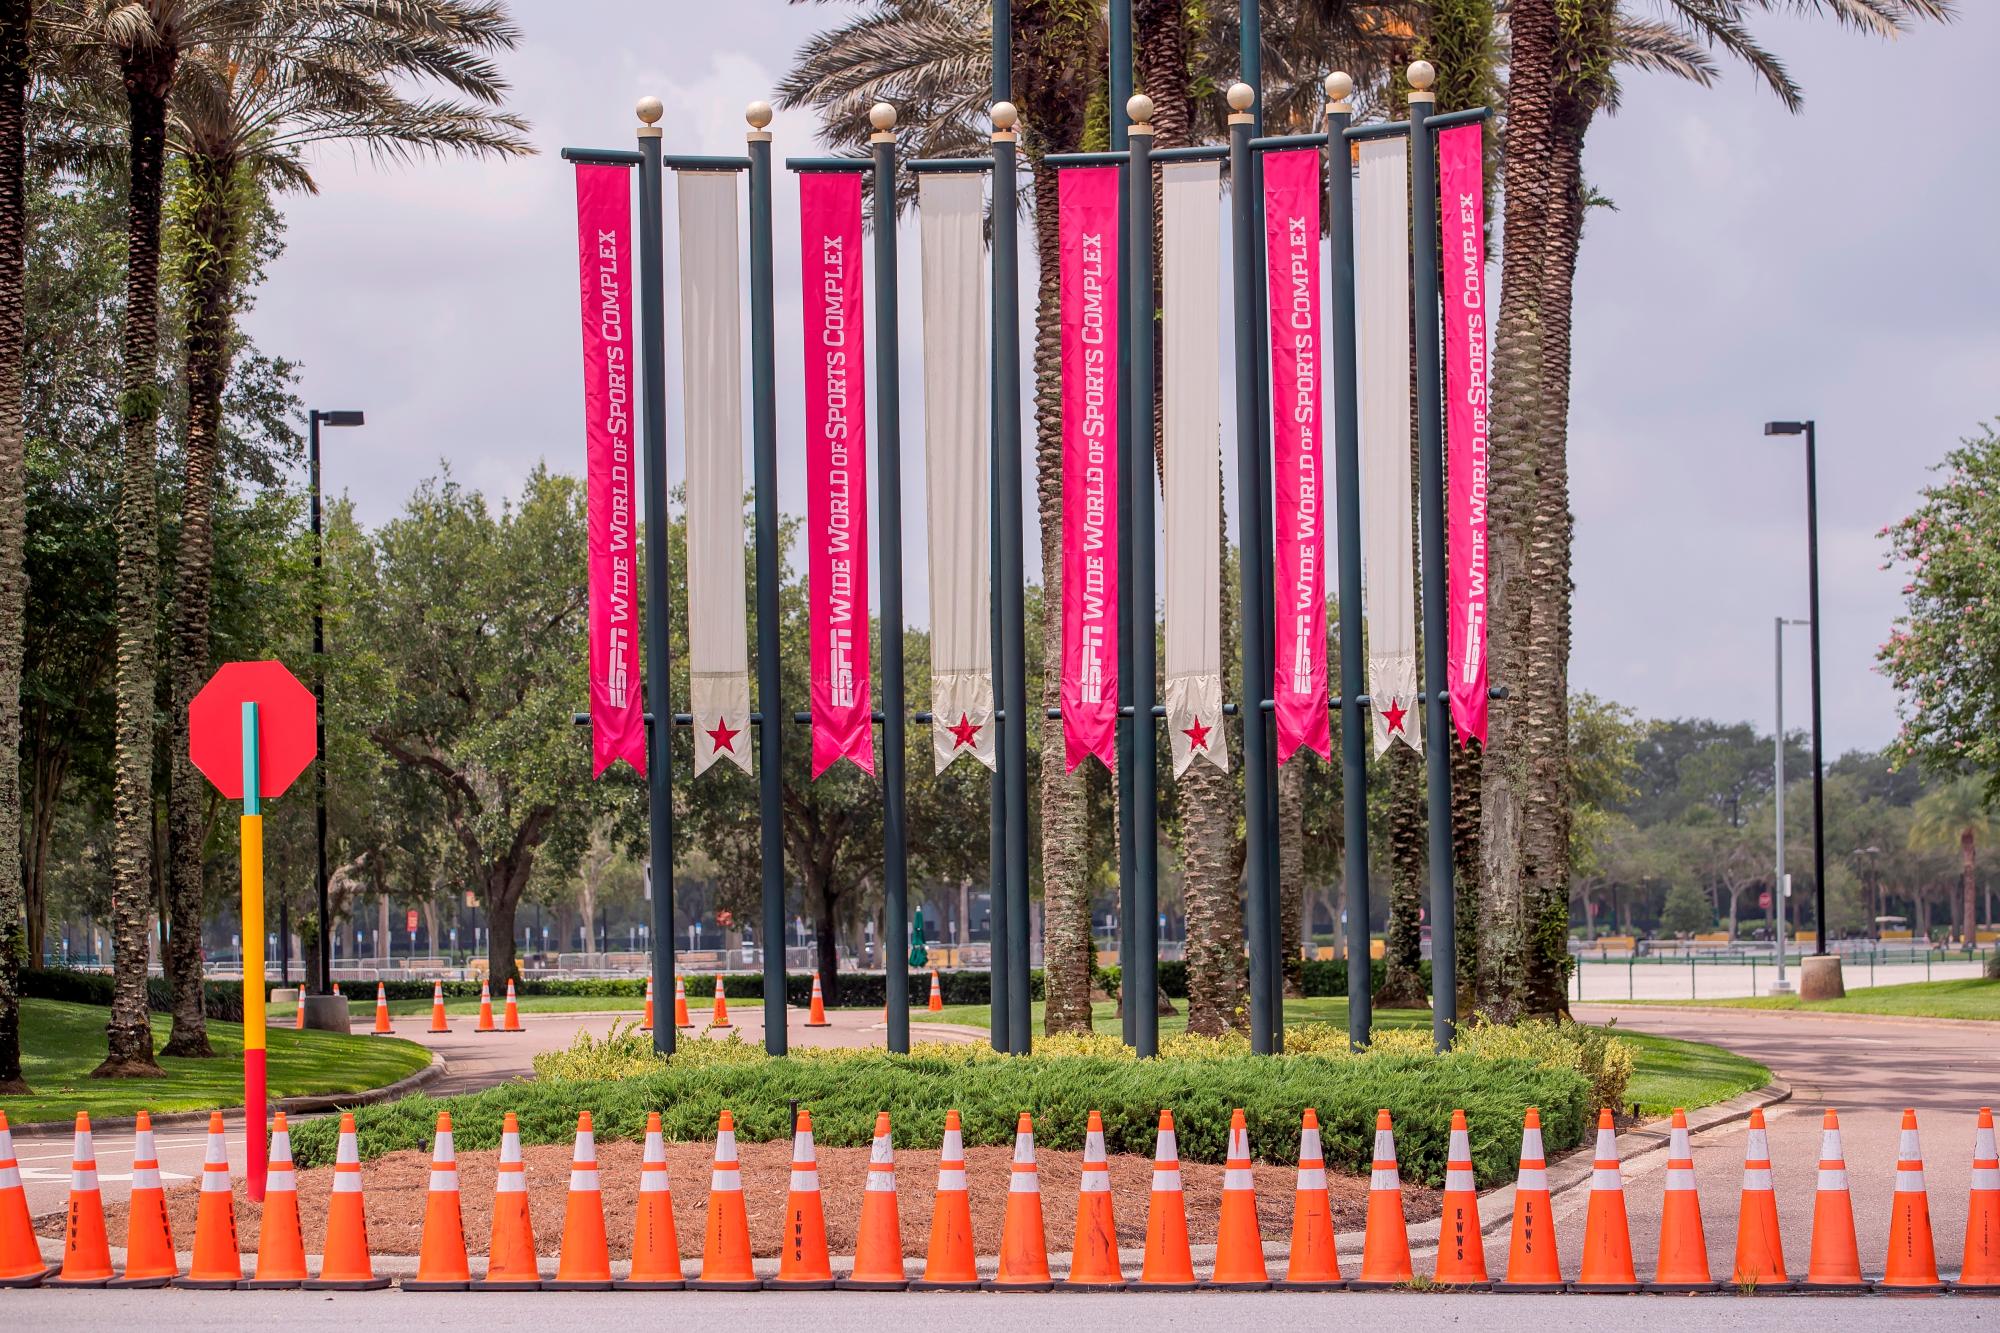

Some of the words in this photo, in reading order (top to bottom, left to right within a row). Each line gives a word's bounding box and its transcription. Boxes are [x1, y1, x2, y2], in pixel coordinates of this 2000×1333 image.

[599, 230, 621, 341] COMPLEX
[824, 236, 844, 346] COMPLEX
[1082, 234, 1103, 344] COMPLEX
[1289, 217, 1311, 328] COMPLEX
[1460, 193, 1481, 310] COMPLEX
[608, 347, 626, 434] SPORTS
[826, 352, 847, 438] SPORTS
[1083, 349, 1104, 437] SPORTS
[1295, 335, 1313, 422] SPORTS
[1468, 312, 1486, 404] SPORTS
[611, 466, 627, 551] WORLD
[828, 471, 849, 554] WORLD
[1084, 468, 1104, 551] WORLD
[1297, 455, 1314, 540] WORLD
[611, 557, 628, 622] WIDE
[830, 559, 851, 623] WIDE
[1083, 556, 1103, 620] WIDE
[1297, 545, 1314, 610] WIDE
[609, 628, 627, 708] ESPN
[831, 629, 853, 707] ESPN
[1080, 626, 1103, 703] ESPN
[1294, 615, 1311, 694] ESPN
[1463, 603, 1483, 684] ESPN
[1456, 1208, 1464, 1260] EWWS
[1525, 1202, 1533, 1253] EWWS
